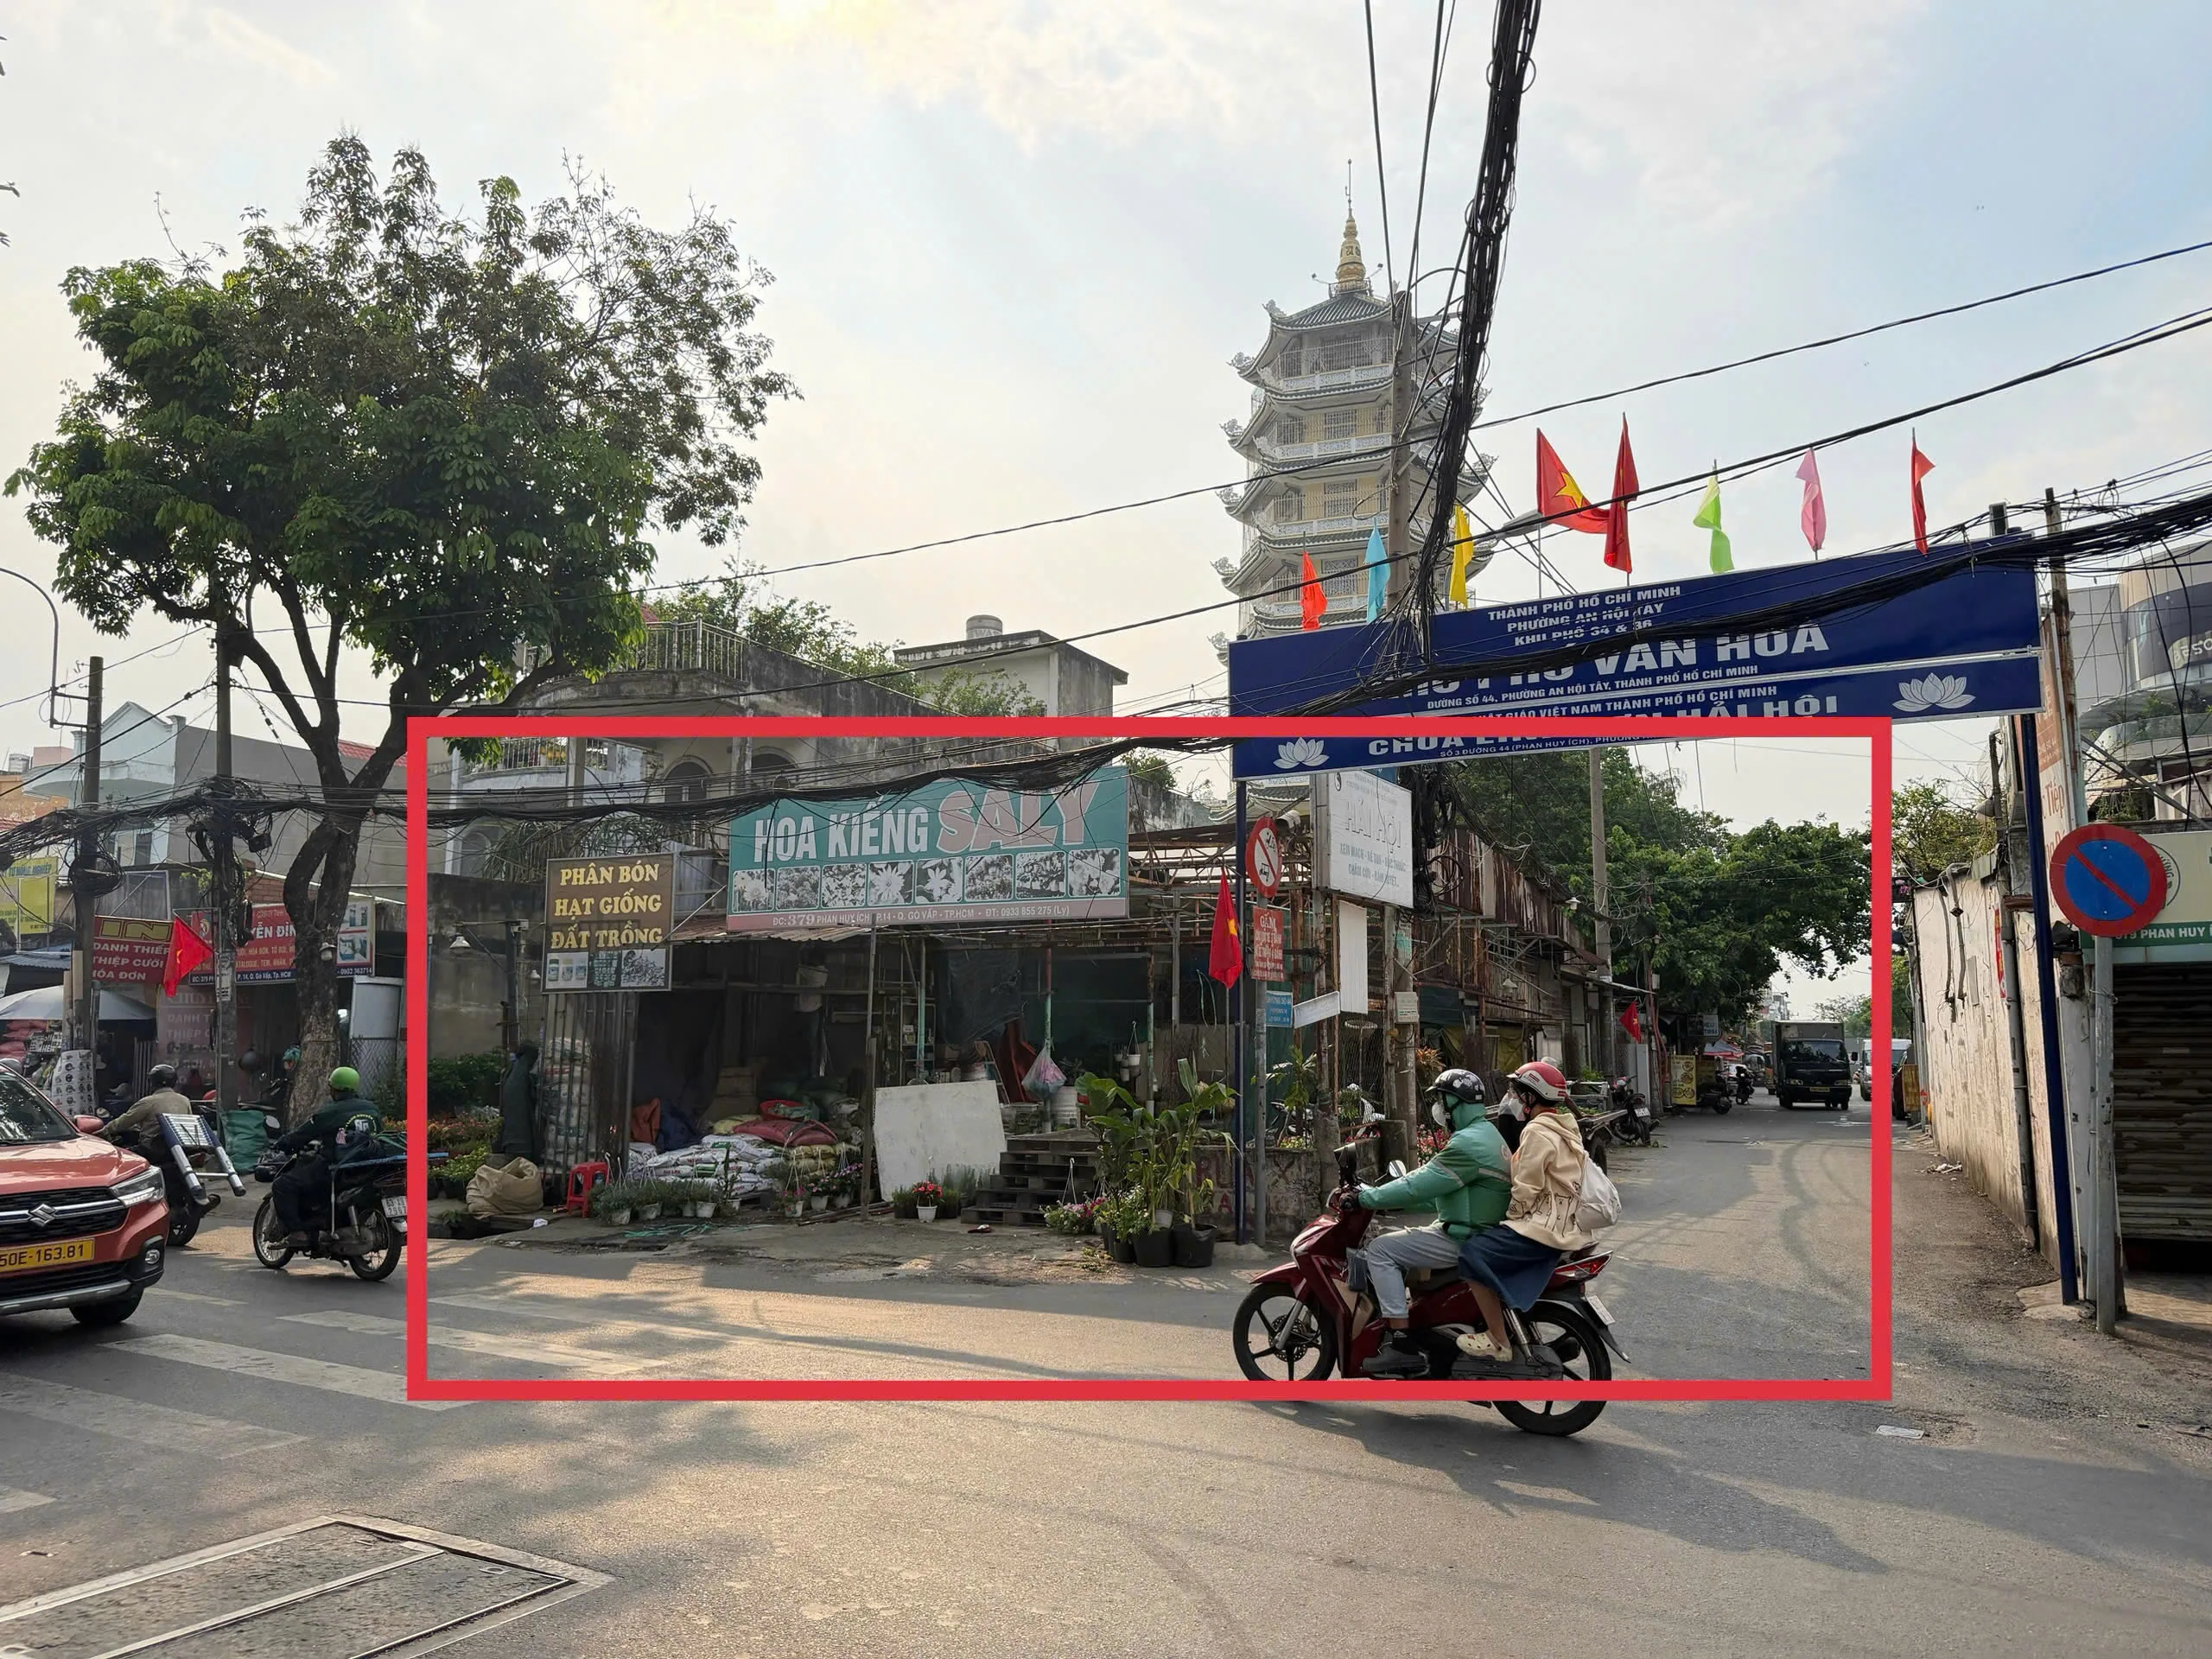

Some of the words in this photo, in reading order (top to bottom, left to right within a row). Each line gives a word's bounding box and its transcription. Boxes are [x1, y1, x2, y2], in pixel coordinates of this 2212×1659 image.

[1488, 603, 1538, 620] THÀNH
[1542, 597, 1575, 613] PHỐ
[1579, 594, 1600, 608] HỒ
[1605, 589, 1631, 605] CHÍ
[1637, 586, 1681, 601] MINH
[1507, 615, 1571, 632] PHƯỜNG
[1575, 612, 1598, 624] AN
[1615, 624, 1628, 633] &
[1427, 697, 1462, 709] ĐƯỜNG
[1465, 693, 1480, 705] SỐ
[1482, 695, 1498, 704] 44,
[1502, 689, 1546, 702] PHƯỜNG
[1548, 686, 1564, 696] AN
[1567, 683, 1586, 695] HỘI
[1590, 680, 1611, 692] TÂY,
[1614, 677, 1652, 689] THÀNH
[1656, 671, 1681, 684] PHỐ
[1683, 668, 1700, 681] HỒ
[1702, 667, 1723, 679] CHÍ
[1726, 665, 1758, 677] MINH
[1540, 704, 1567, 717] VIỆT
[1571, 702, 1602, 715] NAM
[1605, 696, 1651, 711] THÀNH
[1655, 691, 1683, 707] PHỐ
[1709, 688, 1734, 702] CHÍ
[1738, 685, 1777, 699] MINH
[1764, 694, 1839, 718] HỘI
[1462, 746, 1497, 756] ĐƯỜNG
[1511, 741, 1543, 753] (PHAN
[2044, 777, 2065, 817] Tiếp
[753, 815, 817, 863] HOA
[828, 794, 929, 858] KIẾNG
[936, 781, 1100, 854] SALY
[560, 862, 614, 886] PHÂN
[618, 860, 659, 883] BÓN
[554, 898, 594, 920] HẠT
[600, 887, 663, 915] GIỐNG
[817, 915, 837, 924] PHAN
[839, 914, 855, 923] HUY
[856, 912, 870, 922] ÍCH
[908, 911, 920, 920] GÒ
[921, 909, 938, 919] VẤP
[944, 908, 975, 918] TP.HCM
[985, 908, 999, 917] ĐT:
[1001, 907, 1020, 917] 0933
[1021, 906, 1036, 916] 855
[1038, 906, 1052, 915] 275
[1053, 905, 1070, 916] (Ly)
[99, 918, 172, 943] IN
[550, 923, 591, 949] ĐẤT
[595, 919, 664, 948] TRỒNG
[2140, 928, 2176, 938] PHAN
[2178, 926, 2206, 938] HUY
[93, 943, 130, 952] DANH
[92, 956, 130, 968] THIỆP
[132, 958, 164, 969] CƯỚI
[118, 969, 147, 981] ĐƠN
